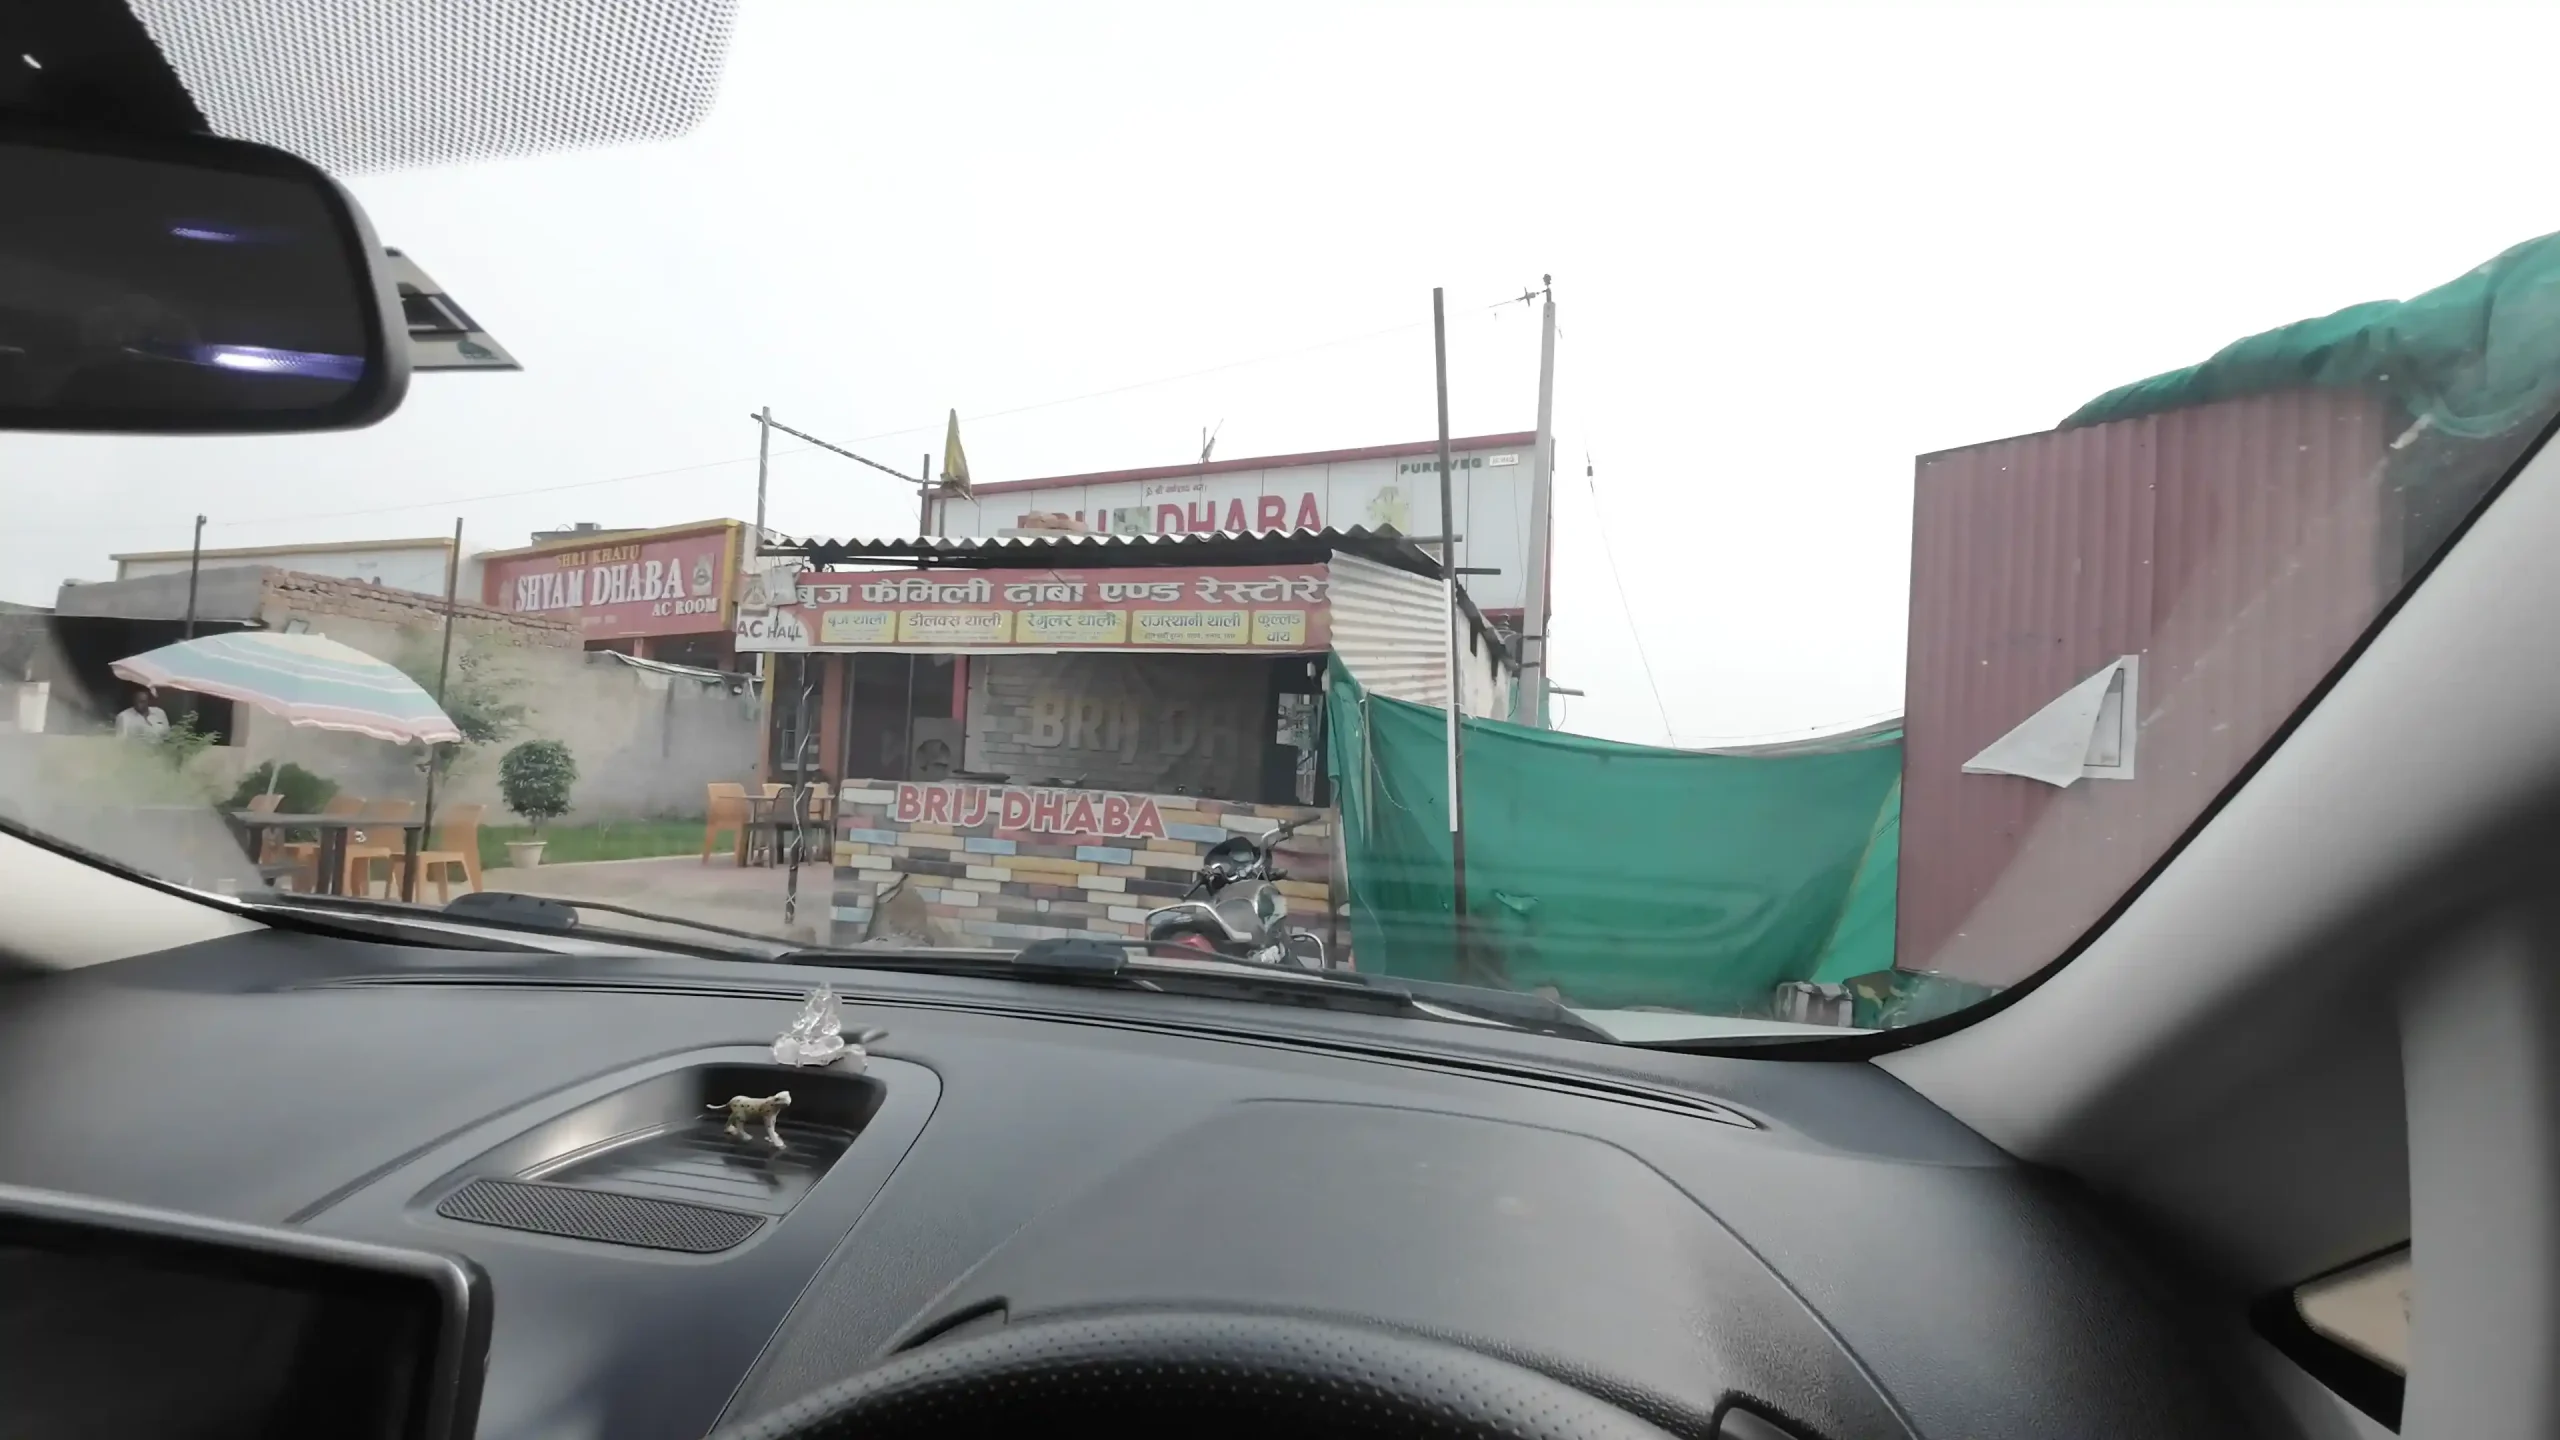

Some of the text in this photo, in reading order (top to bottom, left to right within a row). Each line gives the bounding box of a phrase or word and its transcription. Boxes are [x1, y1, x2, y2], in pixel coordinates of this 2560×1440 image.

[516, 558, 686, 613] SHYAM DHABA
[652, 598, 719, 617] AC ROOM
[737, 620, 803, 639] AC HALL
[896, 783, 1170, 840] BRIJ DHABA
